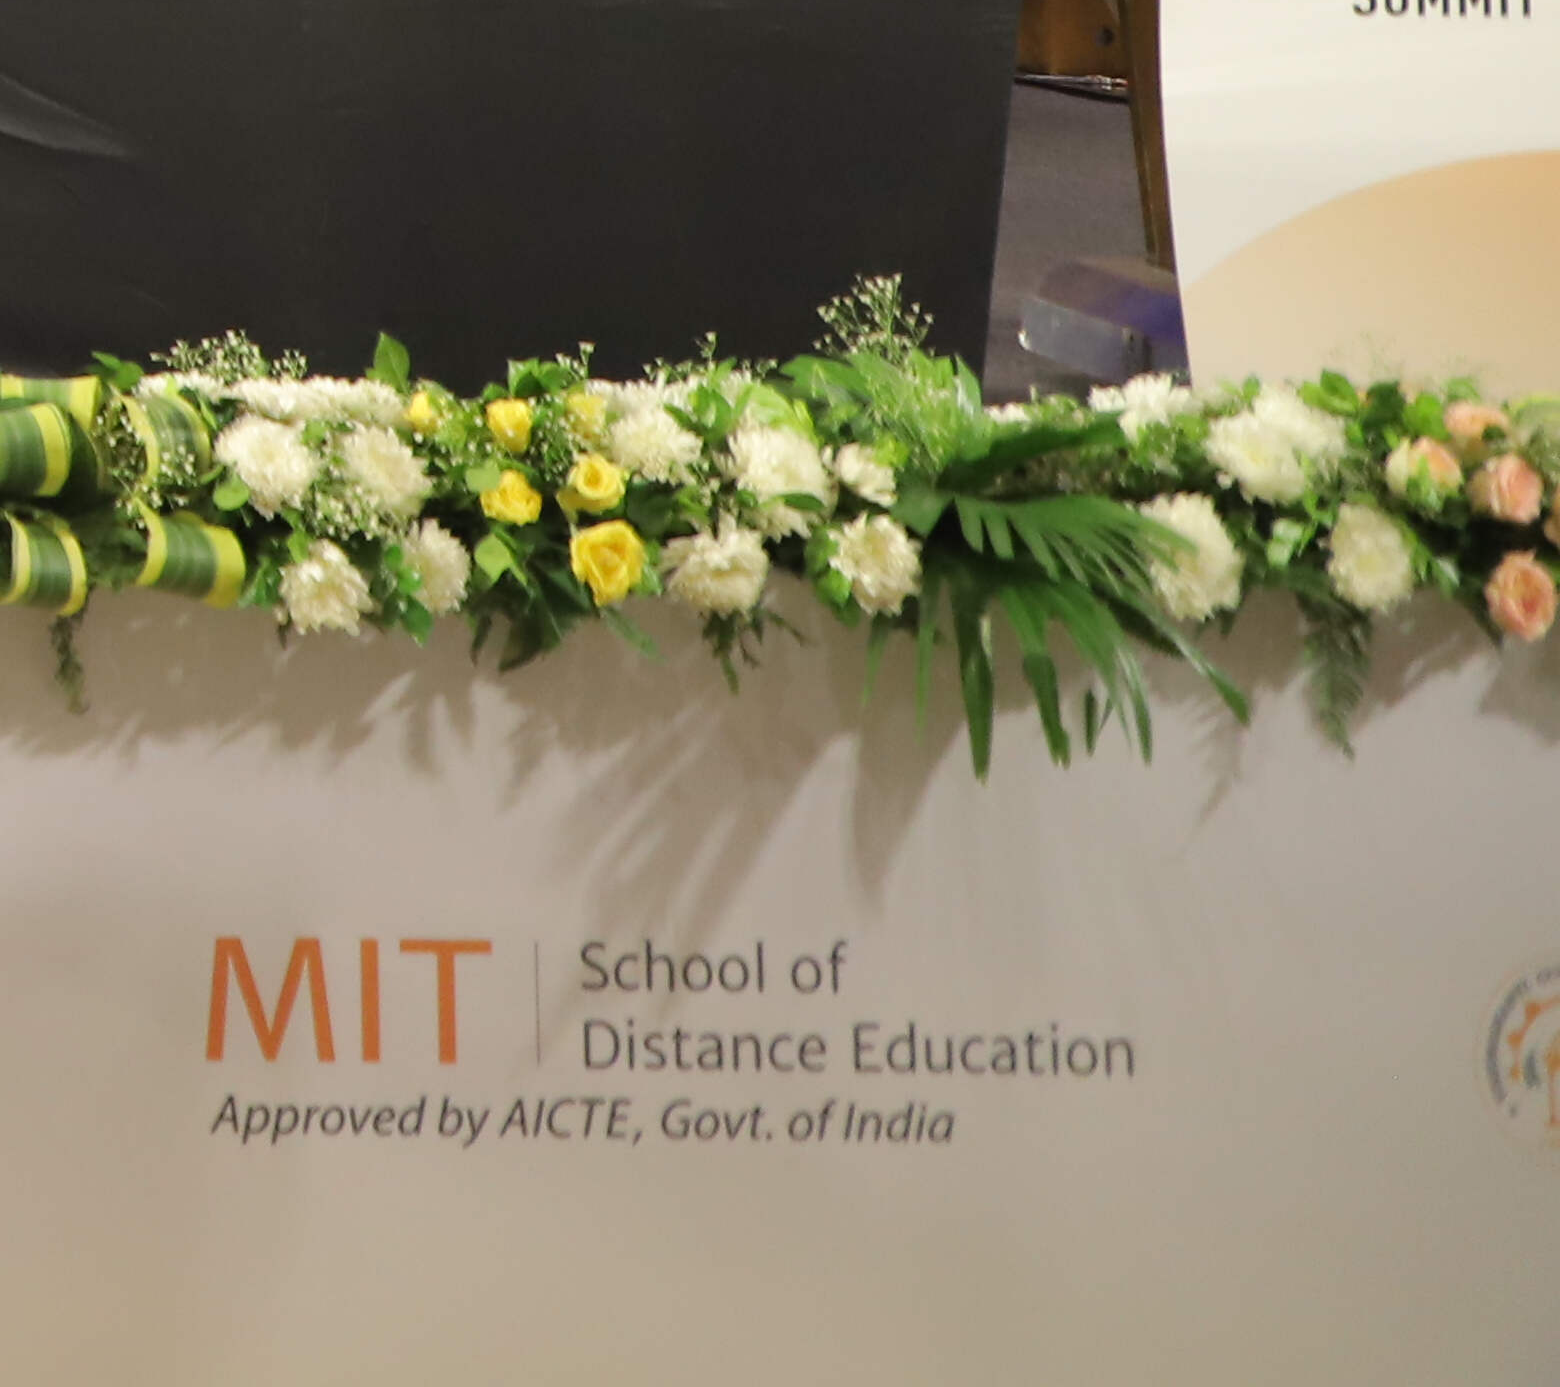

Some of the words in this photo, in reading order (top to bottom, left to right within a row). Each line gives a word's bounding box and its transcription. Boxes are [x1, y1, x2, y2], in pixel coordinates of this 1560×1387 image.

[579, 942, 766, 996] School
[790, 939, 848, 996] of
[205, 936, 491, 1064] MIT
[581, 1020, 826, 1075] Distance
[851, 1023, 1136, 1080] Education
[210, 1095, 425, 1149] Approved
[435, 1095, 490, 1149] by
[499, 1100, 645, 1148] AICTE,
[660, 1101, 773, 1144] Govt.
[785, 1099, 835, 1155] of
[841, 1101, 956, 1148] India
